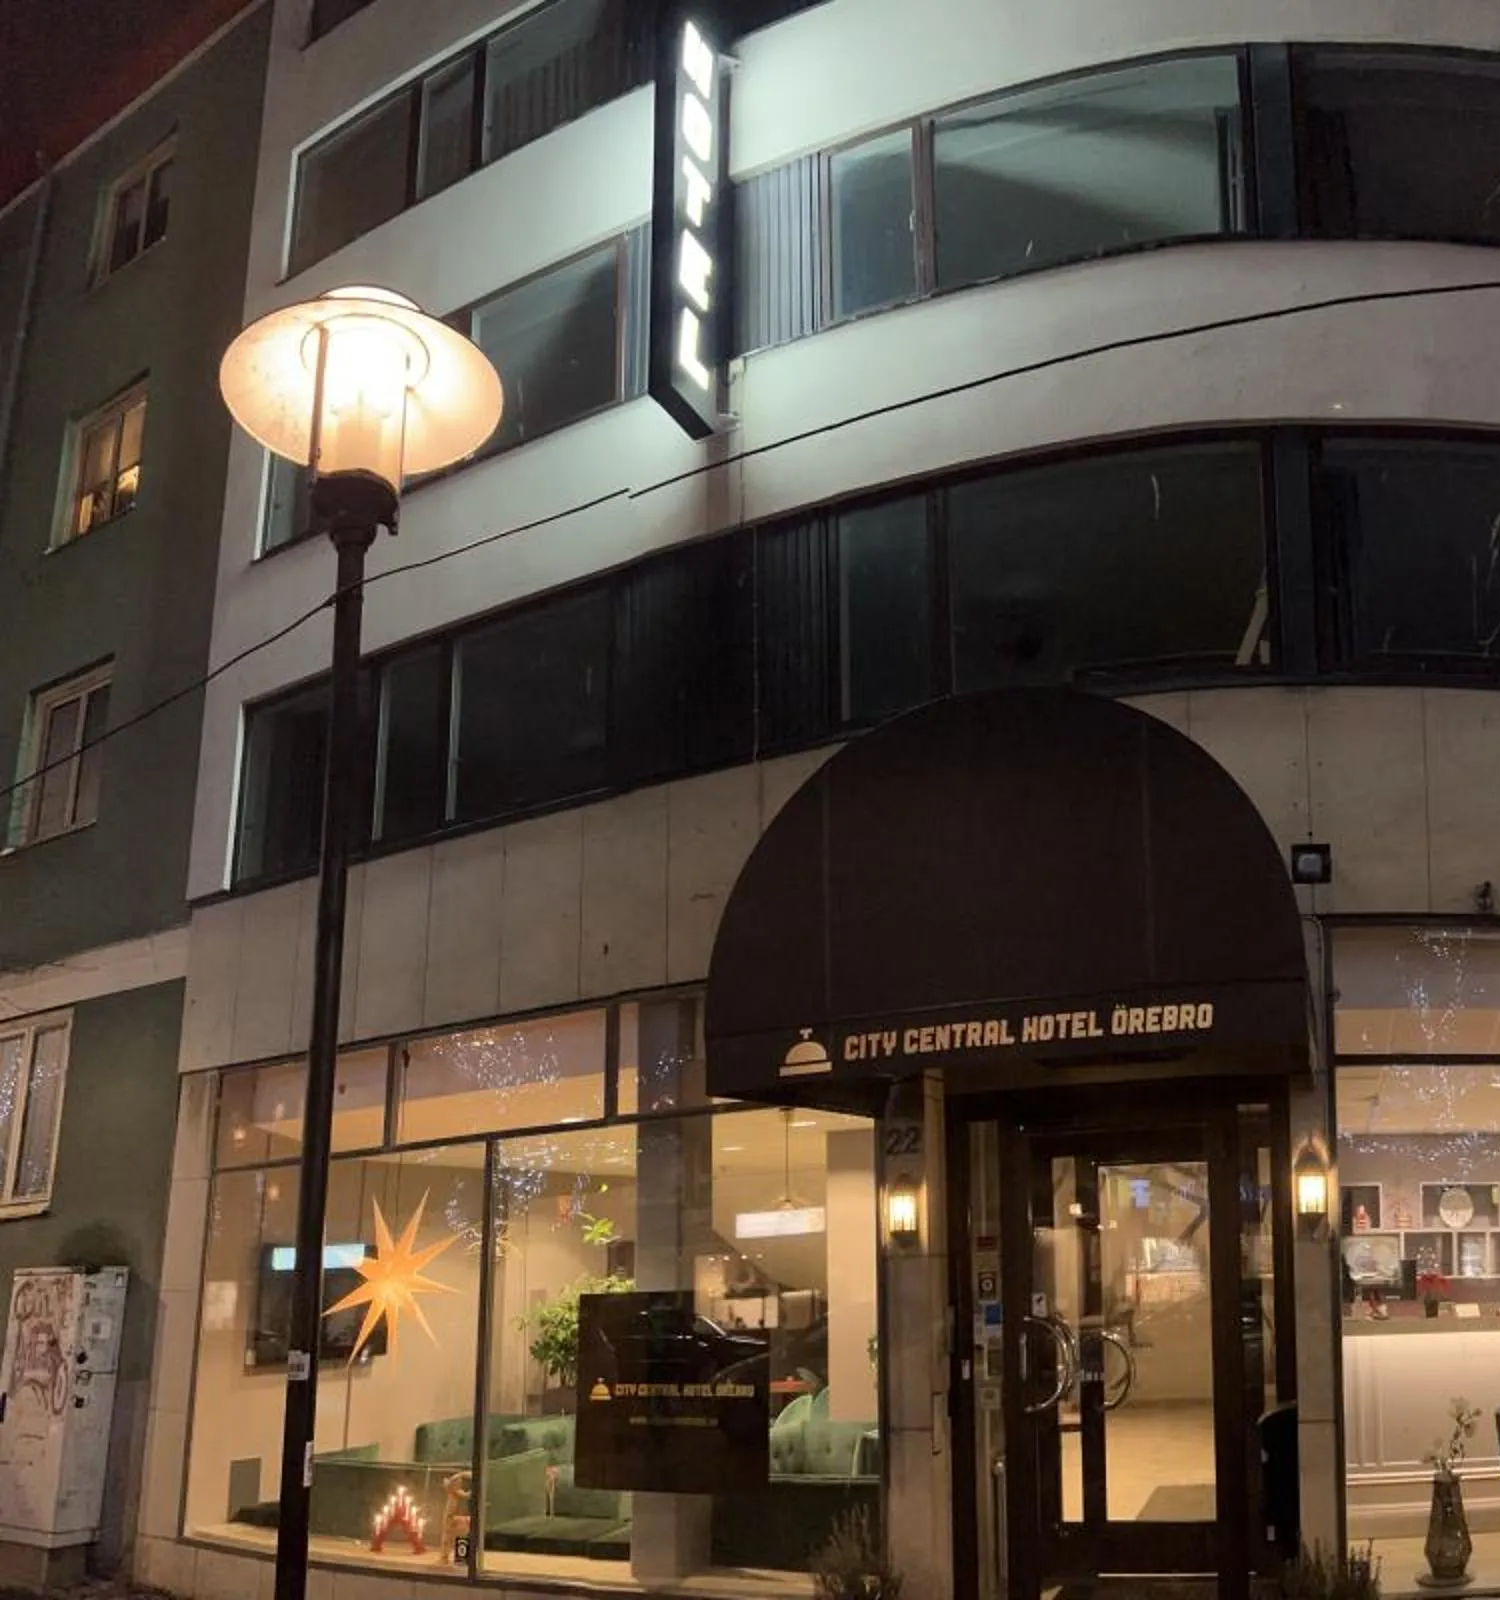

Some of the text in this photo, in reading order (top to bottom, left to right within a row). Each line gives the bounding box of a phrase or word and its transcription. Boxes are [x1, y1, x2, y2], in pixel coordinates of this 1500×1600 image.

[680, 20, 714, 391] HOTEL
[845, 1003, 1213, 1060] CITY CENTRAL HOTEL ÖREBRO
[886, 1126, 920, 1156] 22
